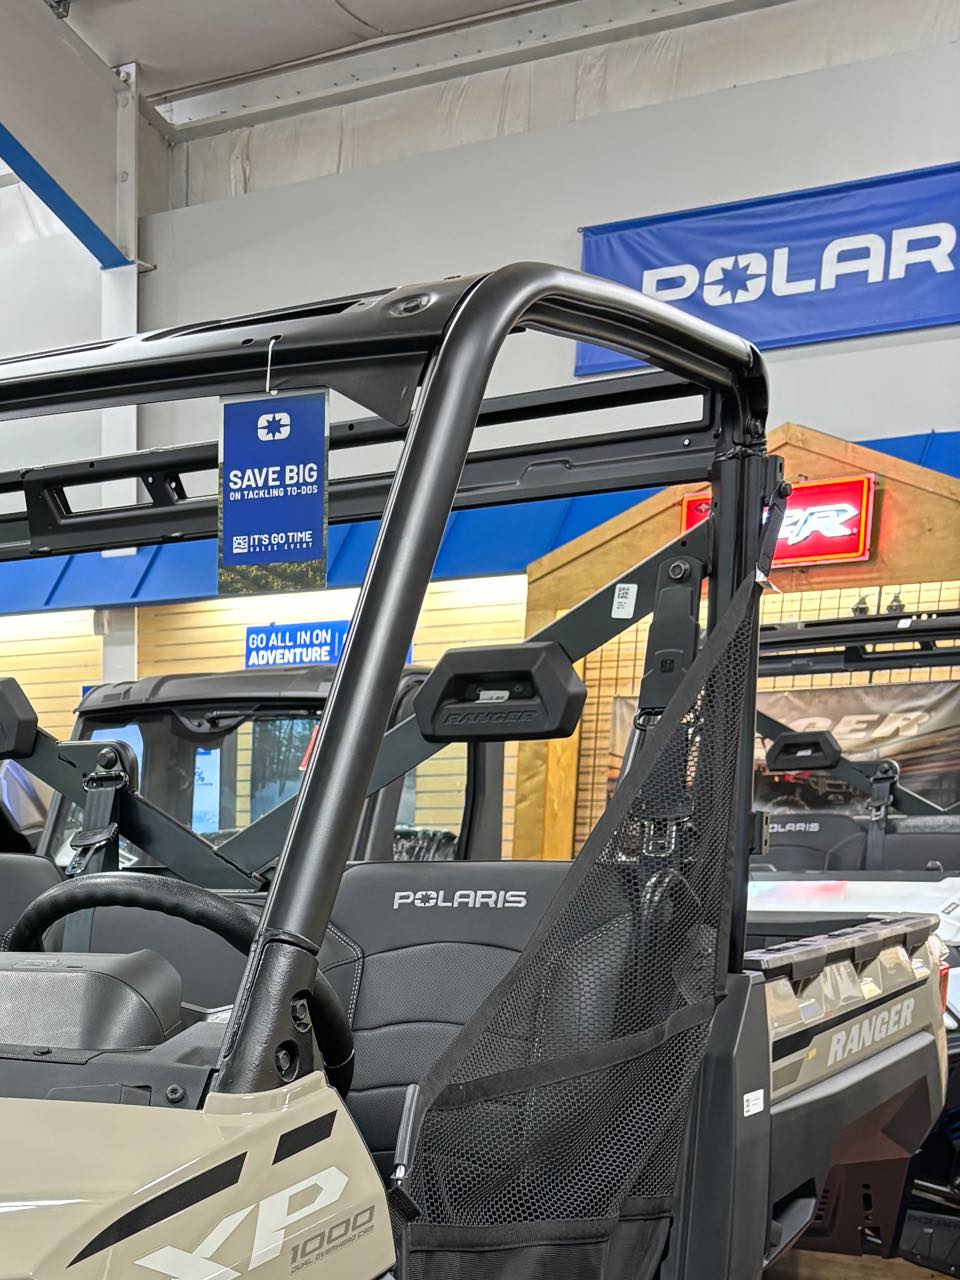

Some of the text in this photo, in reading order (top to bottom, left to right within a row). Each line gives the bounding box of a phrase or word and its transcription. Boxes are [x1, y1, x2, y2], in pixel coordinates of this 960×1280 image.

[229, 463, 318, 489] SAVE BIG
[229, 485, 318, 501] ON TACKLING TO-DOS
[250, 530, 313, 546] IT'S GO TIME
[248, 629, 331, 648] GO ALL IN ON
[248, 645, 330, 666] ADVENTURE
[443, 709, 539, 726] RANGER
[393, 890, 527, 910] POLARIS
[826, 997, 915, 1067] RANGER
[290, 1205, 376, 1265] 1000
